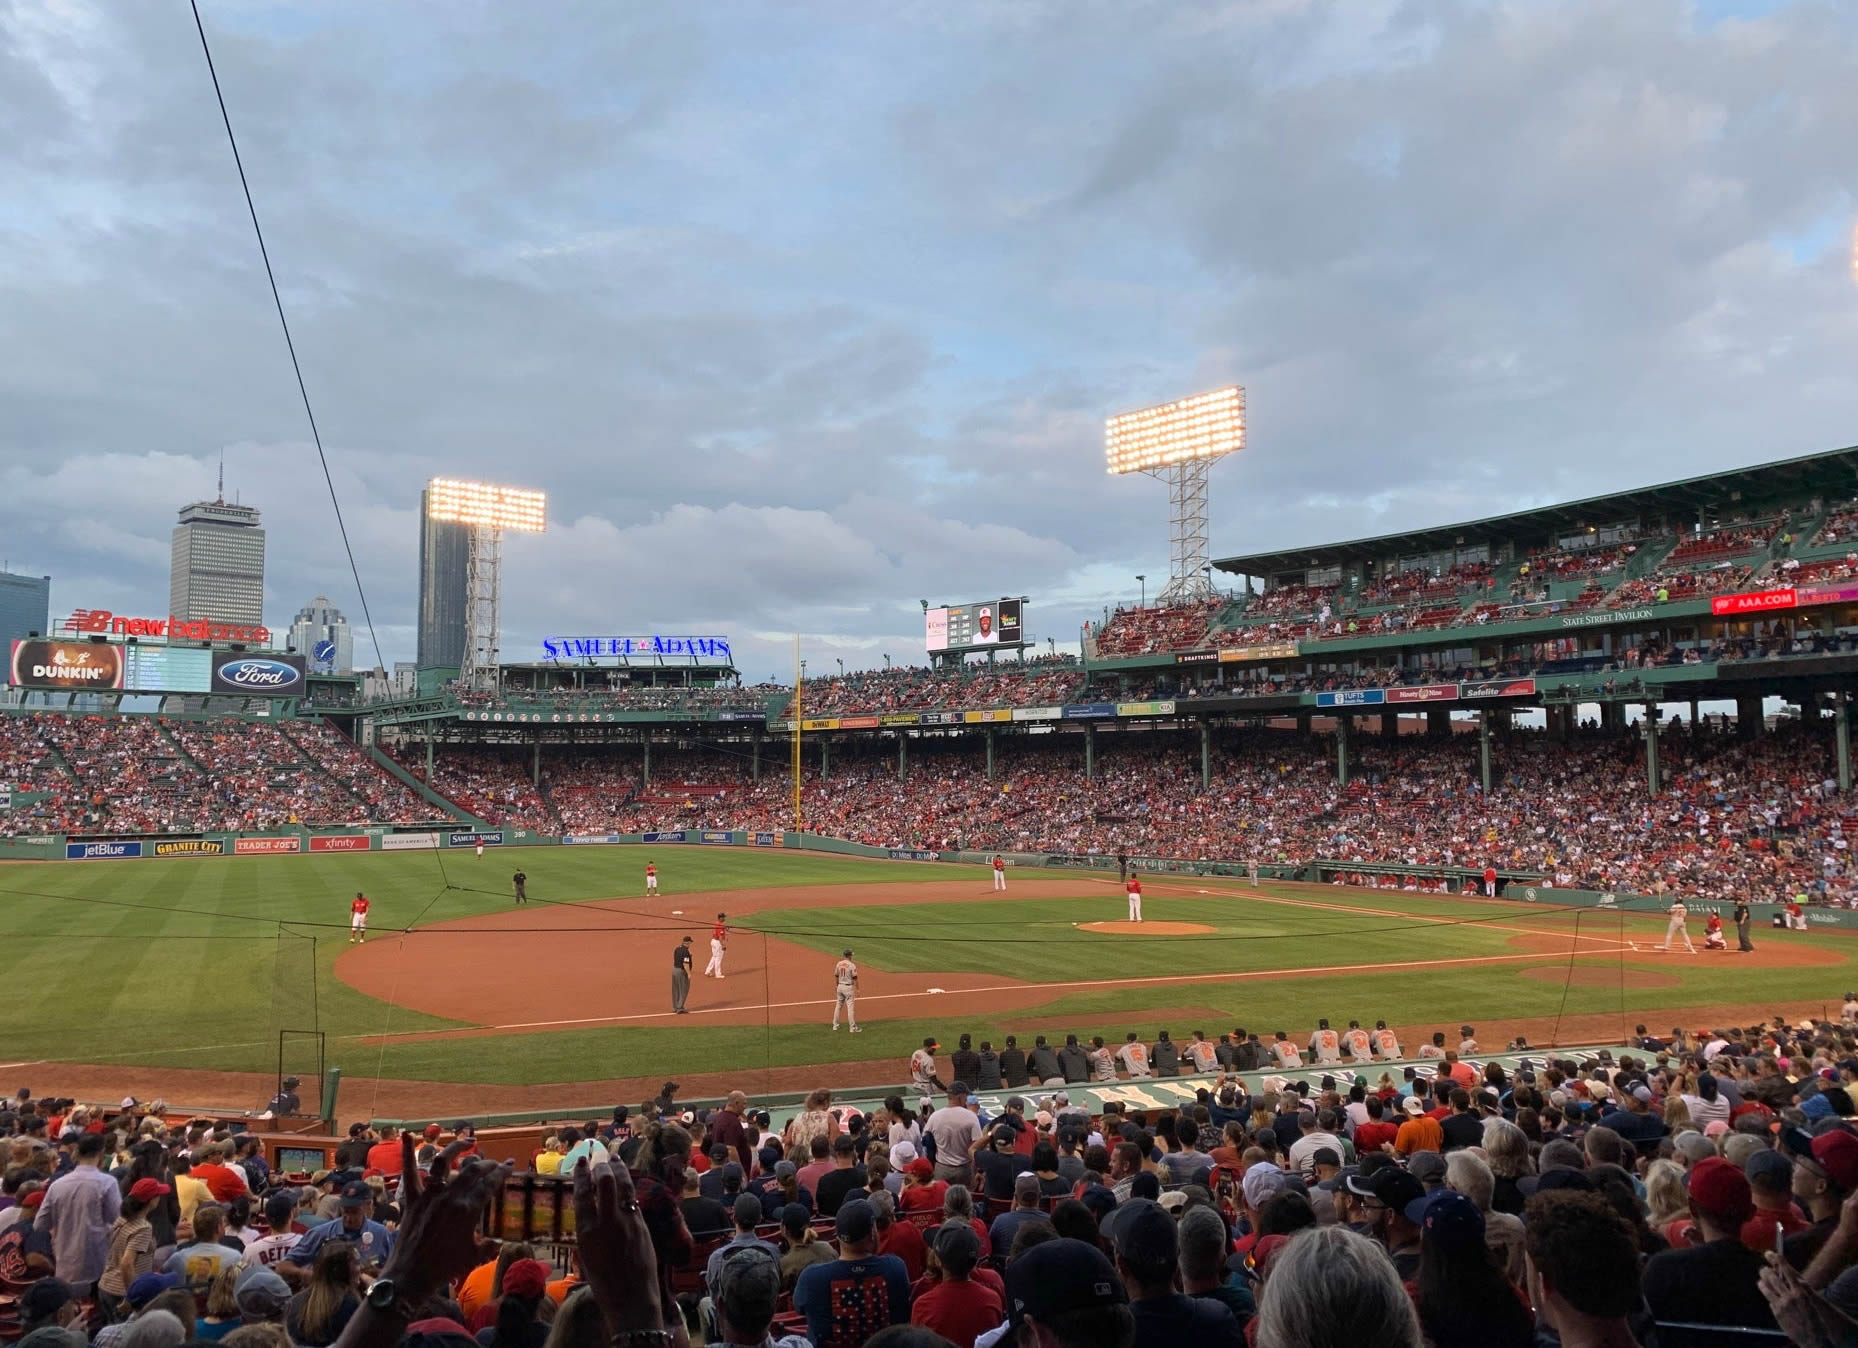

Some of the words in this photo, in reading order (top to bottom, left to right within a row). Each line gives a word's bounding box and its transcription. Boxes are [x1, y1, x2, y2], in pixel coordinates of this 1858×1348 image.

[1738, 594, 1792, 608] AAA.COM
[1563, 617, 1585, 627] STATE
[1585, 613, 1613, 624] STREET
[1614, 609, 1653, 621] PAVILION
[112, 616, 167, 636] new
[168, 615, 270, 642] balance
[543, 635, 636, 660] SAMUEL
[651, 635, 730, 656] ADAMS
[33, 665, 103, 680] DUNKIN'
[240, 663, 283, 684] Ford
[1400, 690, 1418, 699] Ninety
[1429, 689, 1443, 697] Nine
[1467, 688, 1499, 697] Safelite
[238, 841, 271, 850] TRADER
[274, 840, 297, 849] JOE'S
[325, 837, 356, 848] xfinity
[452, 834, 476, 843] SAMUEL
[83, 844, 125, 858] jetBlue
[157, 840, 200, 854] GRANITE
[201, 840, 222, 852] CITY
[1282, 1043, 1298, 1057] 24
